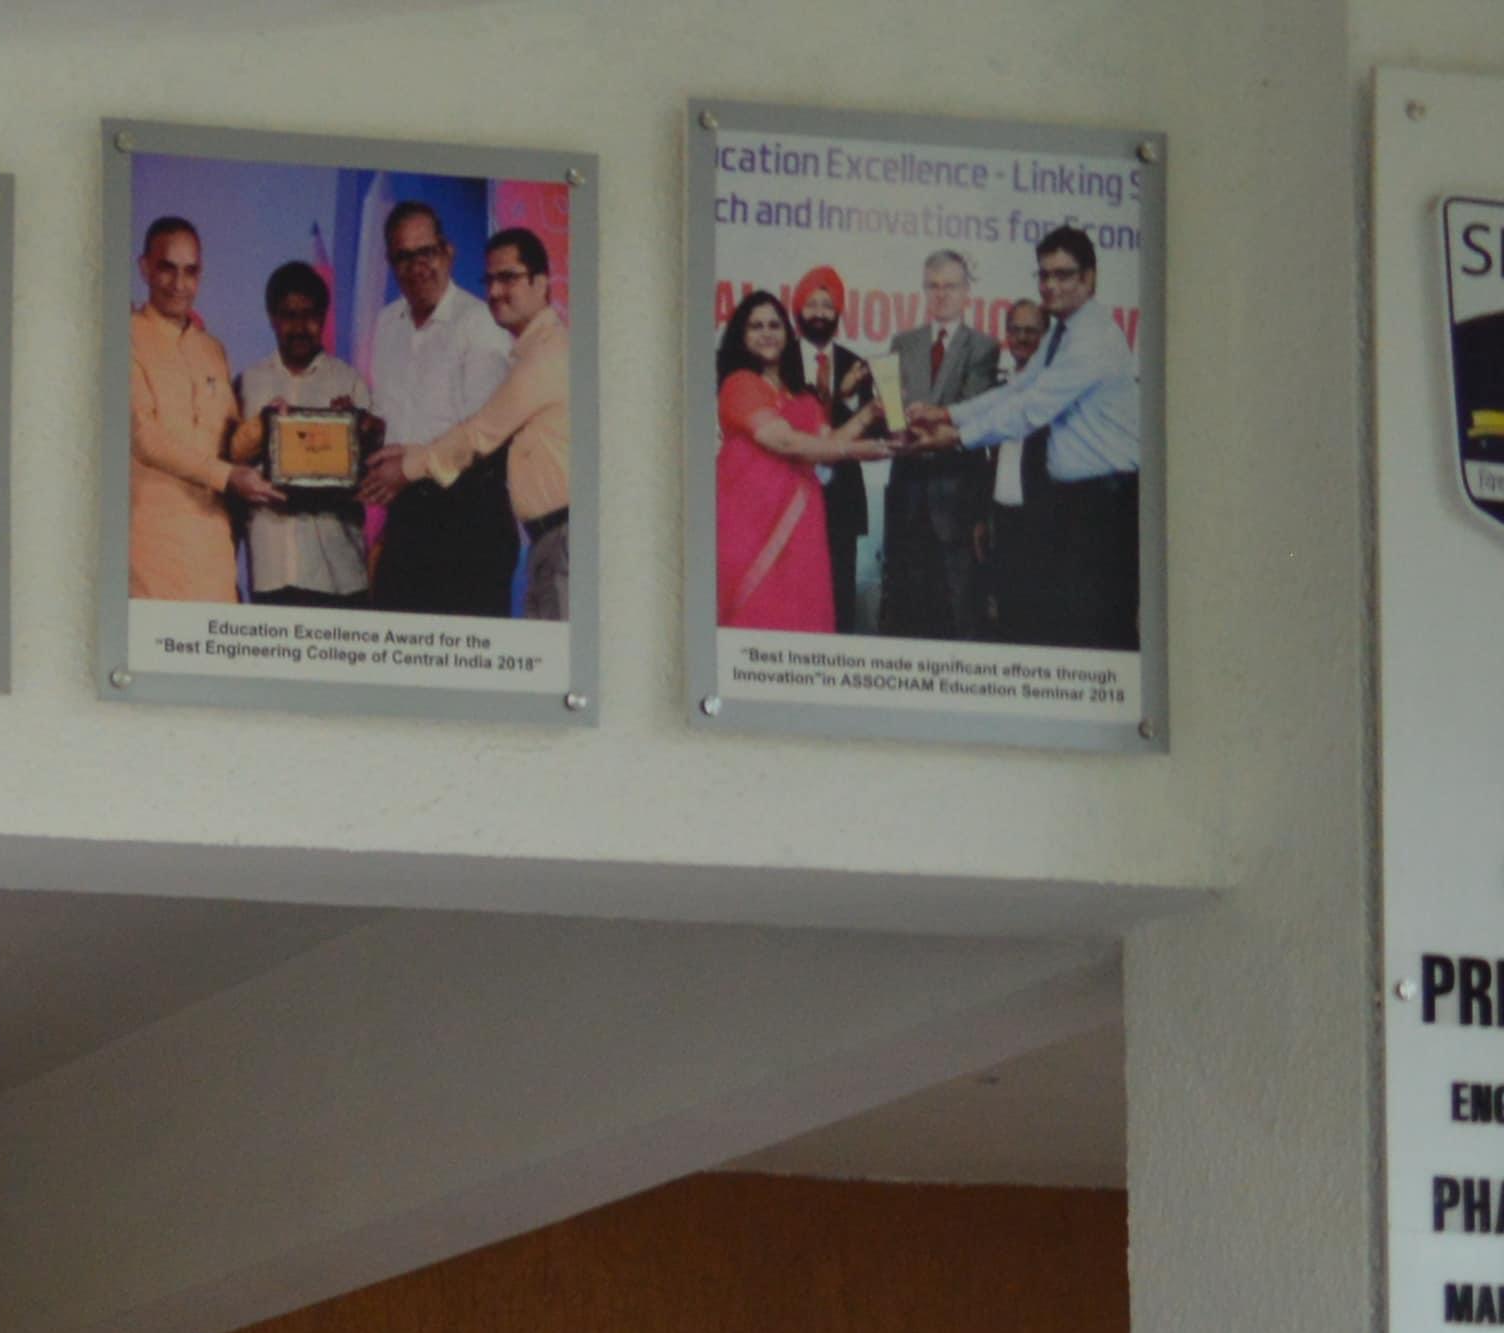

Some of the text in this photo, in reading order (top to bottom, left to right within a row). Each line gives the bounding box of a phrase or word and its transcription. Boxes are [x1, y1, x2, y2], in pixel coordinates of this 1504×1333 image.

[827, 147, 988, 189] Excellence
[1013, 161, 1123, 207] Linking
[755, 198, 811, 230] and
[819, 199, 999, 243] Innovations
[207, 619, 491, 650] Education Excellence Award for the
[204, 641, 302, 663] Engineering
[305, 646, 368, 665] College
[371, 648, 388, 665] of
[391, 649, 450, 668] Central
[453, 652, 493, 670] India
[788, 650, 867, 669] Institution
[871, 655, 913, 671] made
[917, 658, 998, 677] significant
[1002, 662, 1052, 680] efforts
[1056, 665, 1117, 685] through
[840, 674, 935, 693] ASSOCHAM
[939, 678, 1017, 698] Education
[1021, 684, 1083, 701] Seminar
[1089, 688, 1125, 704] 2018
